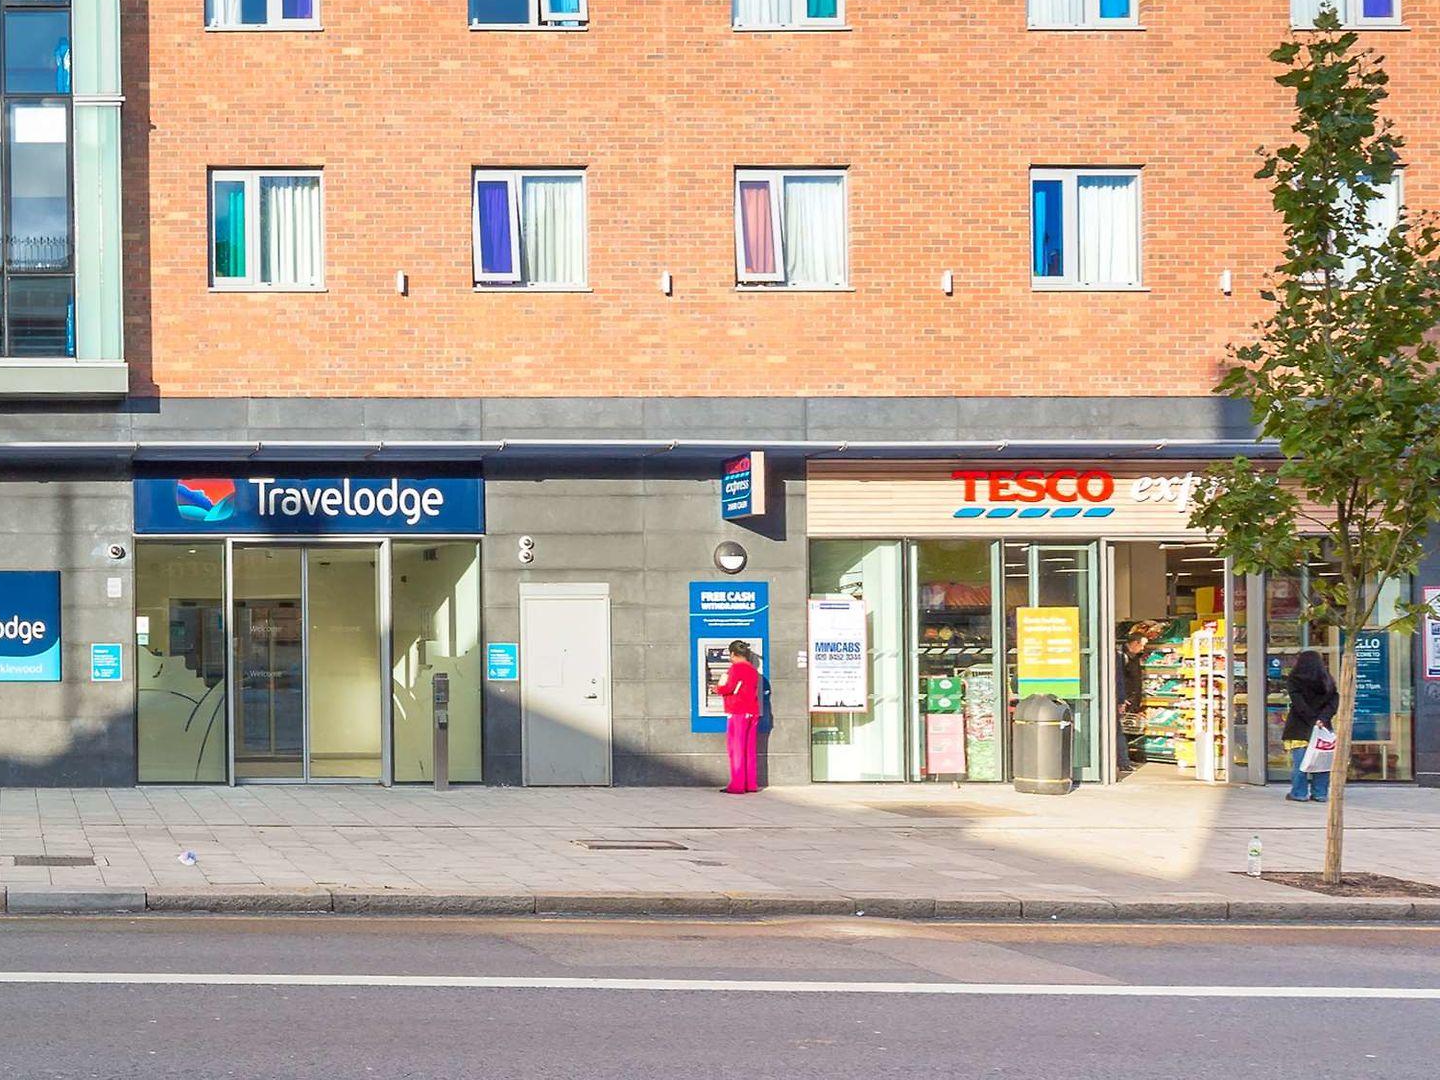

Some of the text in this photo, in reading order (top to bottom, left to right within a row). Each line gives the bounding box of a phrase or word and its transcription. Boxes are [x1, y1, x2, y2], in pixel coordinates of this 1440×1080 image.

[951, 467, 1115, 503] TESCO
[248, 478, 444, 525] Travelodge
[701, 591, 756, 602] FREE CASH
[815, 641, 861, 653] MINICABS
